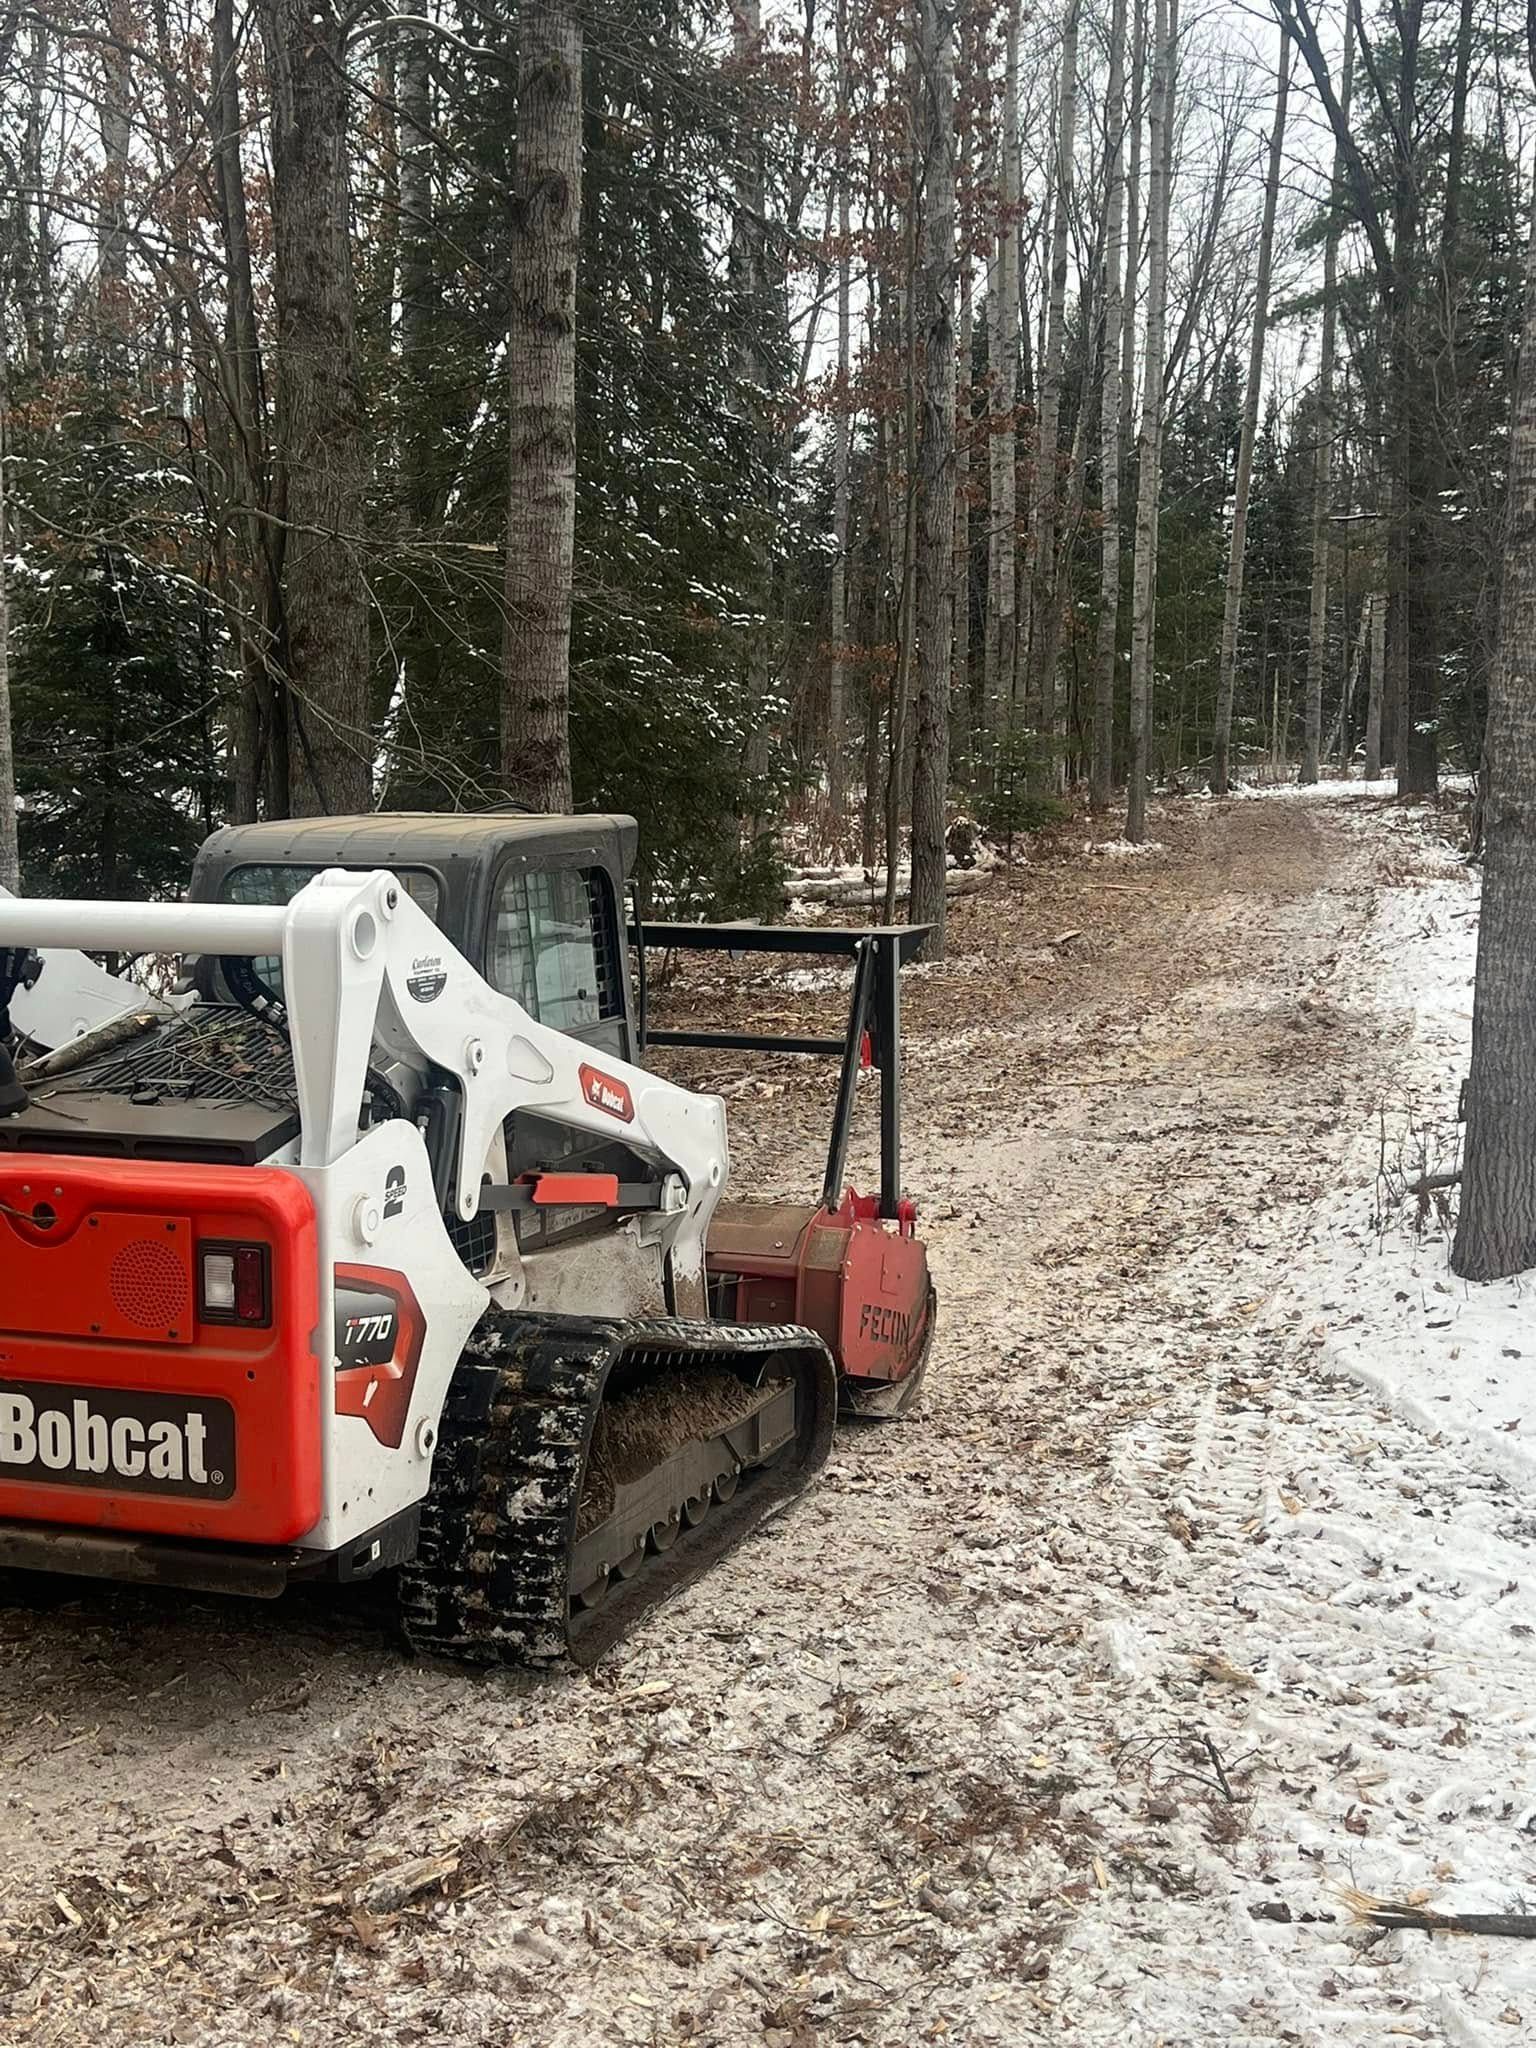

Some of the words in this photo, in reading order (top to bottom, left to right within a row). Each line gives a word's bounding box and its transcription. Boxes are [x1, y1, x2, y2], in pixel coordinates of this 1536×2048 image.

[601, 1085, 625, 1113] Bobcat
[383, 1164, 406, 1220] 2
[344, 1313, 393, 1345] T770
[858, 1303, 911, 1346] FECON
[0, 1392, 208, 1484] Bobcat
